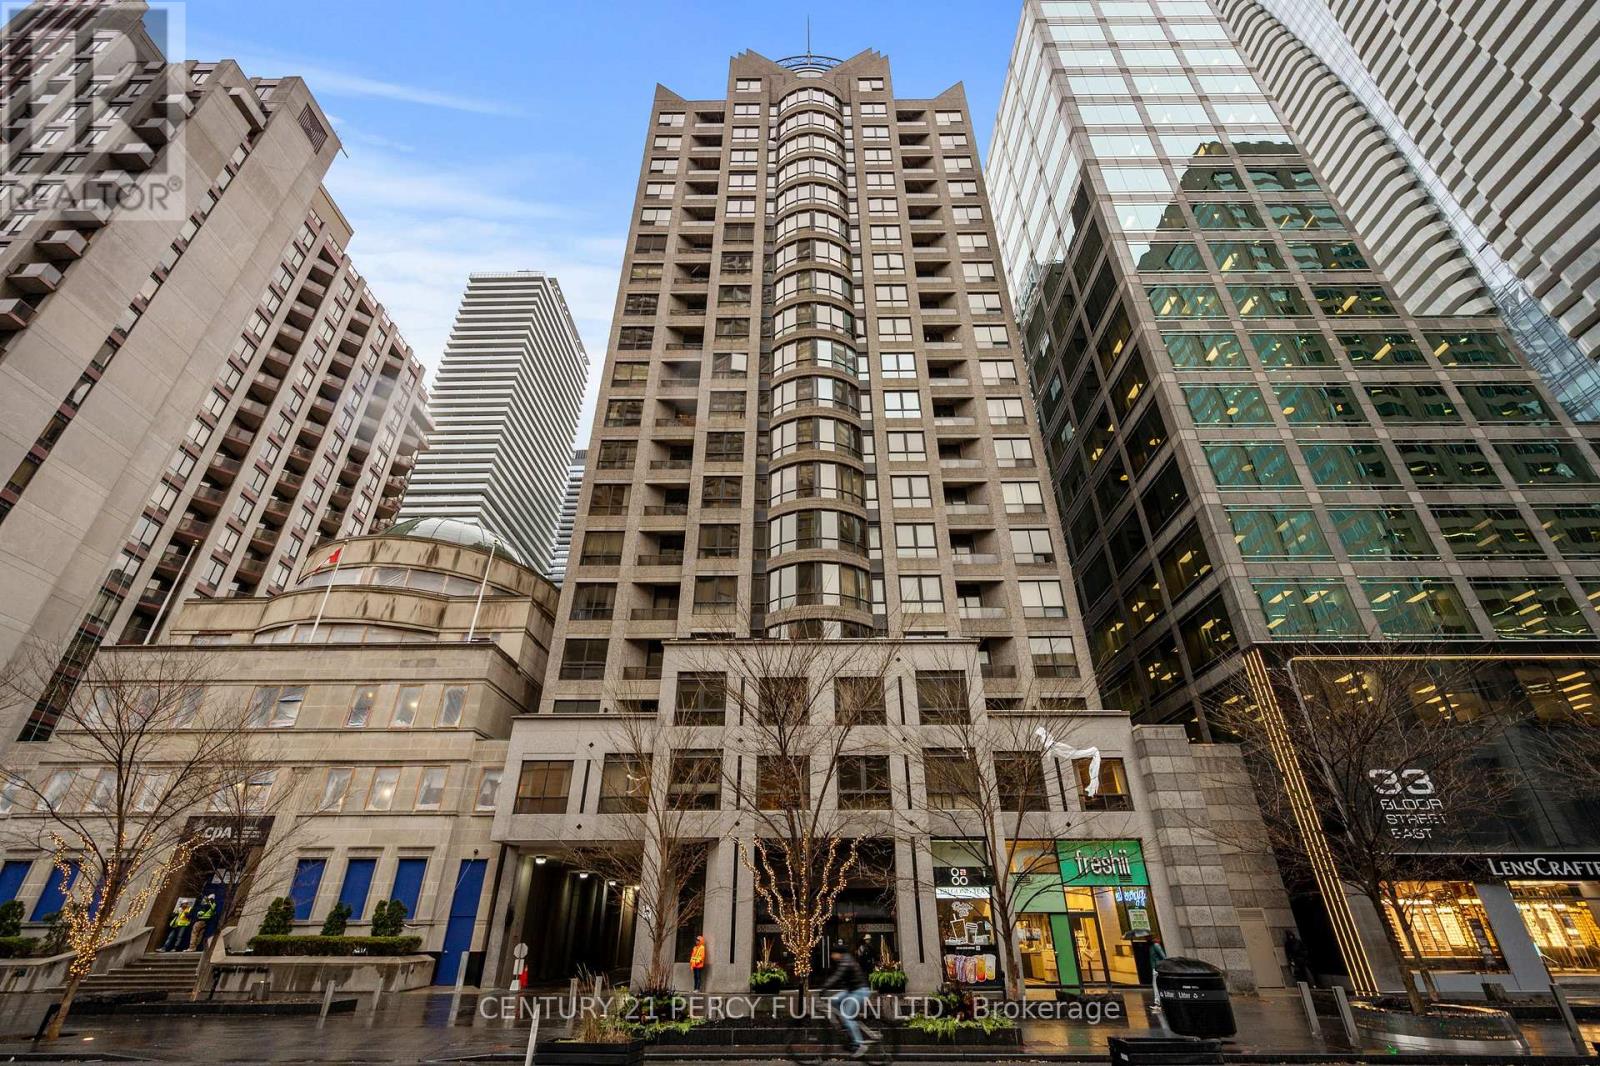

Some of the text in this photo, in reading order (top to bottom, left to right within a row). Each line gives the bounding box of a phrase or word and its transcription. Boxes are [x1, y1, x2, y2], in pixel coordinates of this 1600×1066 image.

[1369, 769, 1435, 795] 33
[1380, 798, 1444, 810] BLOOR
[1386, 814, 1447, 825] STREET
[204, 826, 232, 841] CPA
[1391, 828, 1432, 839] EAST
[1075, 849, 1131, 876] freshii
